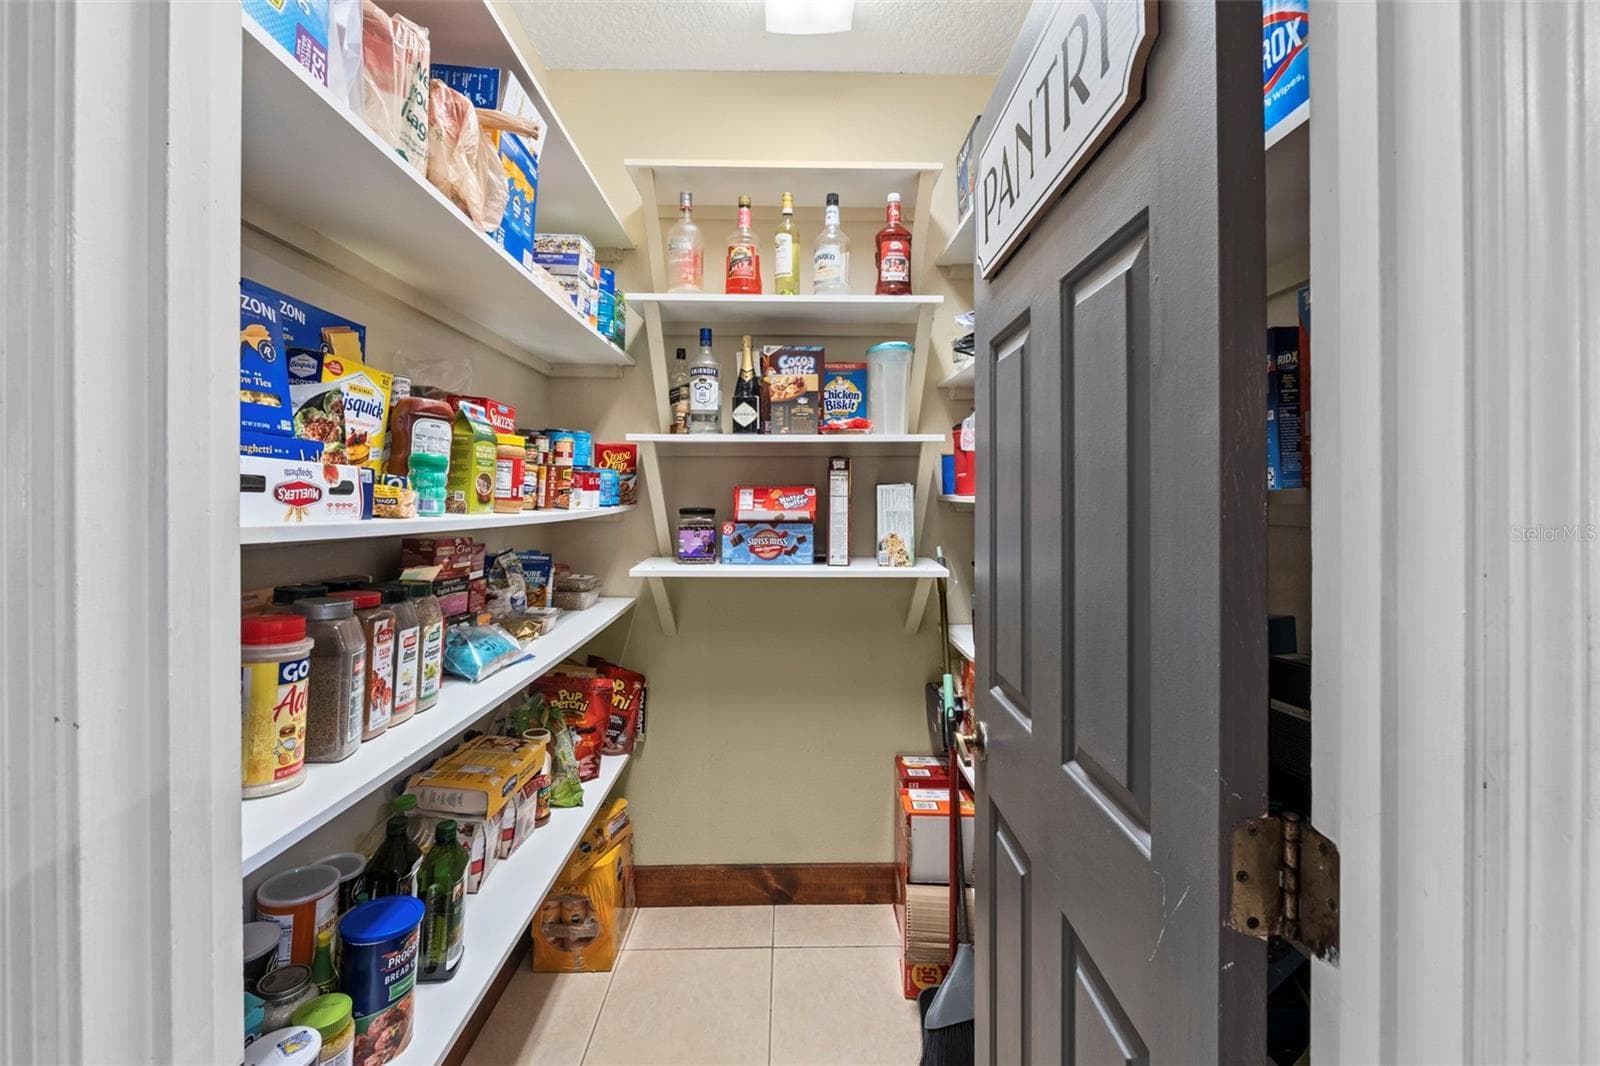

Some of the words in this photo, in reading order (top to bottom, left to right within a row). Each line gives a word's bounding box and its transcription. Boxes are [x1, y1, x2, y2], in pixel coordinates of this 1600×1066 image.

[983, 0, 1110, 246] PANTRY
[279, 300, 306, 325] ZONI
[779, 355, 815, 369] Cocoa
[824, 388, 860, 401] Chicken
[341, 392, 384, 418] isquick
[825, 400, 856, 412] Biskit
[599, 449, 632, 469] Stove
[611, 462, 628, 473] Top
[277, 487, 320, 502] MUELLER'S
[778, 494, 806, 504] Nutter
[783, 498, 809, 510] Butter
[384, 964, 410, 985] BREAD
